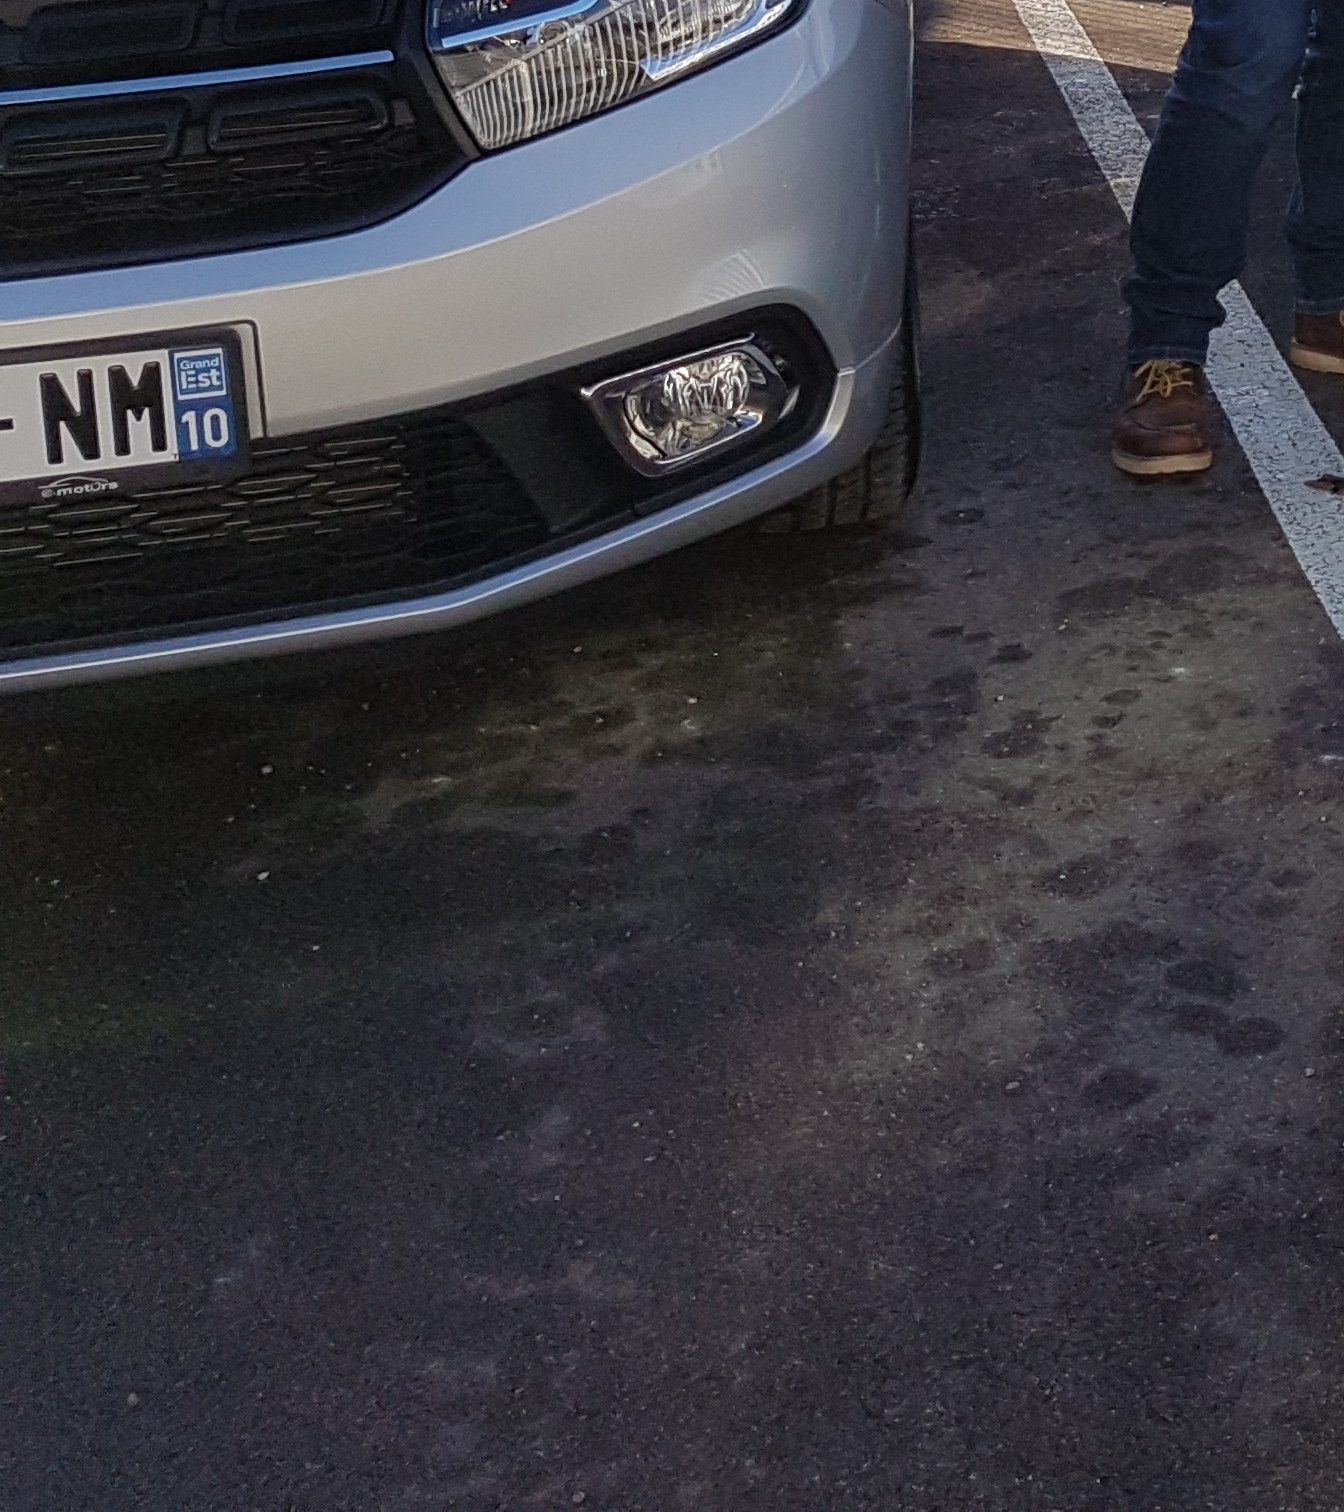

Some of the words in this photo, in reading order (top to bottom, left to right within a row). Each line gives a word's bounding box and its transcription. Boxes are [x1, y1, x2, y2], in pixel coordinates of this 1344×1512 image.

[180, 356, 219, 370] Grand
[180, 368, 221, 390] Est
[181, 407, 229, 451] 10
